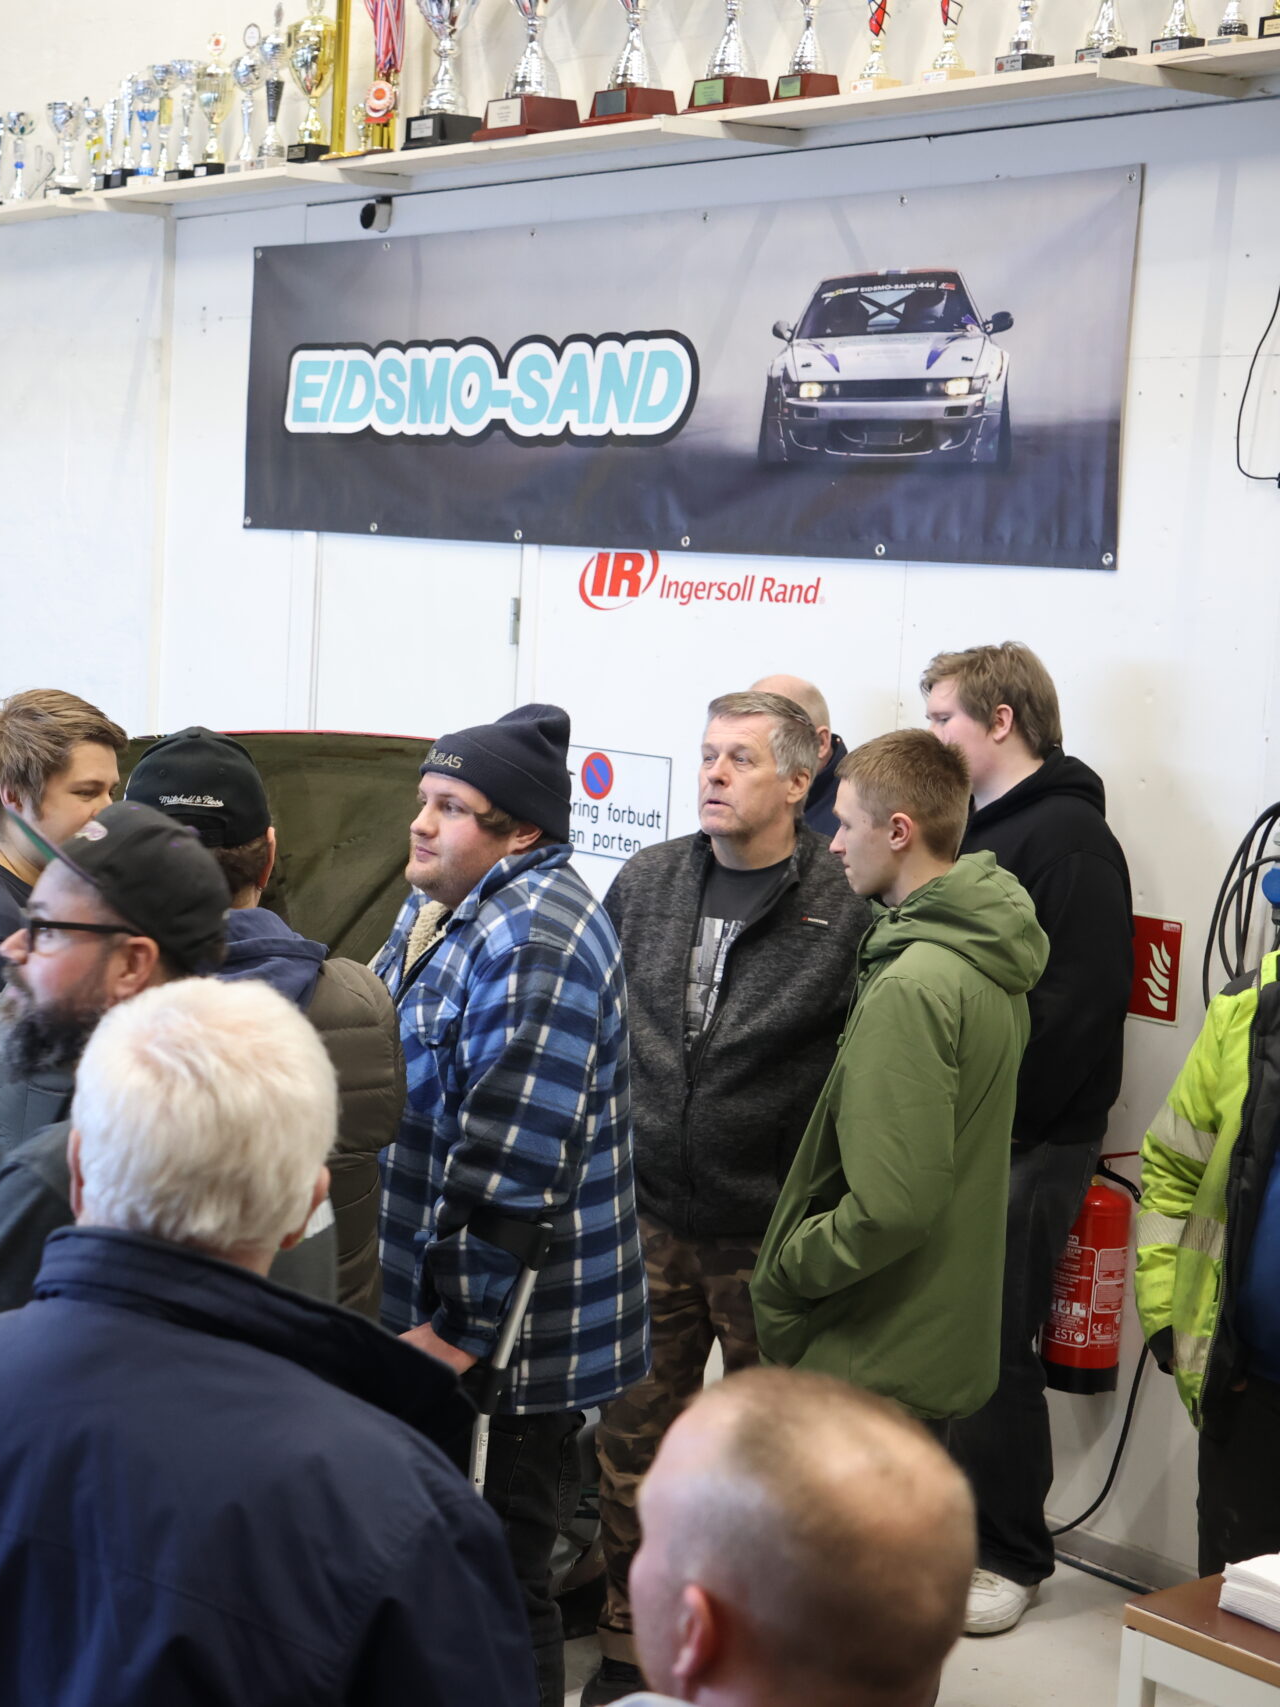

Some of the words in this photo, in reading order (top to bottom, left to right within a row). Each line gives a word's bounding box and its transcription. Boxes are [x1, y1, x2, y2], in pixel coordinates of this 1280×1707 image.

[289, 347, 686, 428] EIDSMO-SAND
[590, 551, 646, 598] IR
[659, 574, 755, 606] Ingersoll
[759, 576, 822, 605] Rand
[572, 797, 600, 824] ring
[607, 802, 662, 830] forbudt
[569, 828, 586, 845] an
[593, 832, 642, 853] porten
